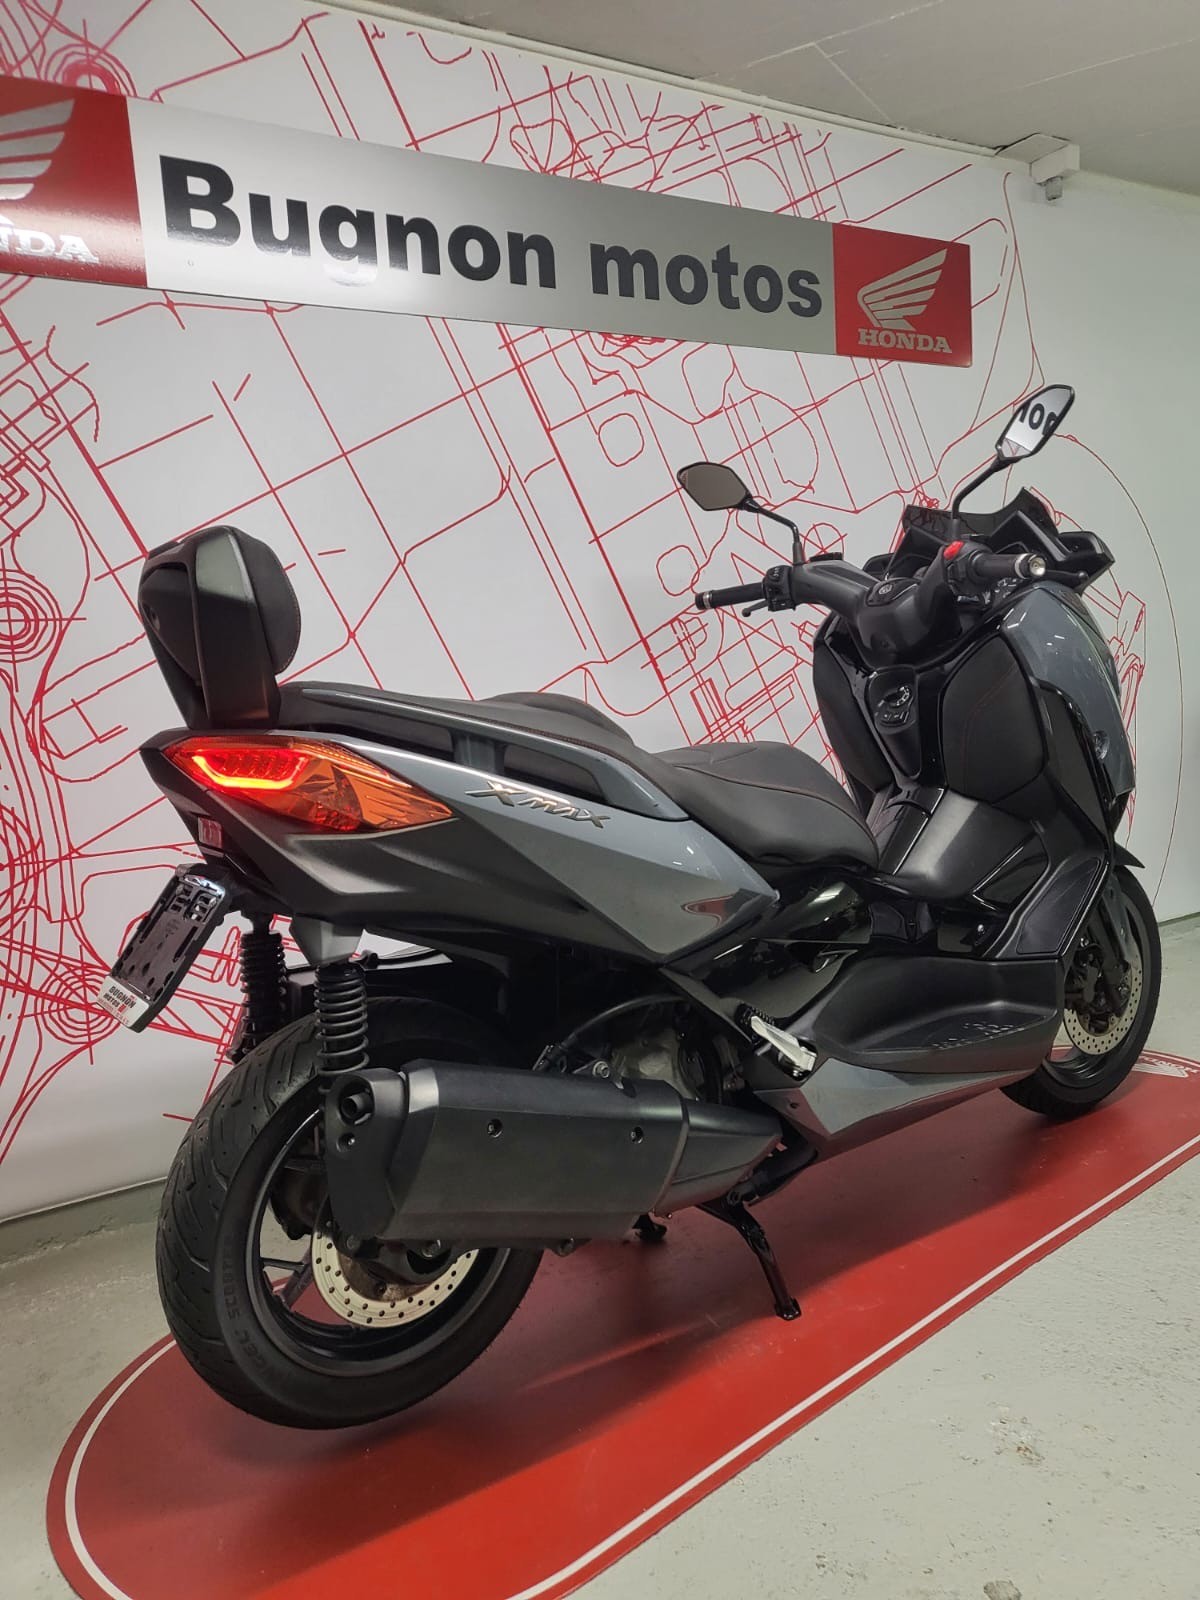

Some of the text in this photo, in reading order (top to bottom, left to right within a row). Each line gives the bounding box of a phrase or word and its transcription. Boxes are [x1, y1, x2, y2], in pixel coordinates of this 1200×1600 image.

[159, 154, 823, 318] Bugnon motos
[857, 328, 953, 354] HONDA
